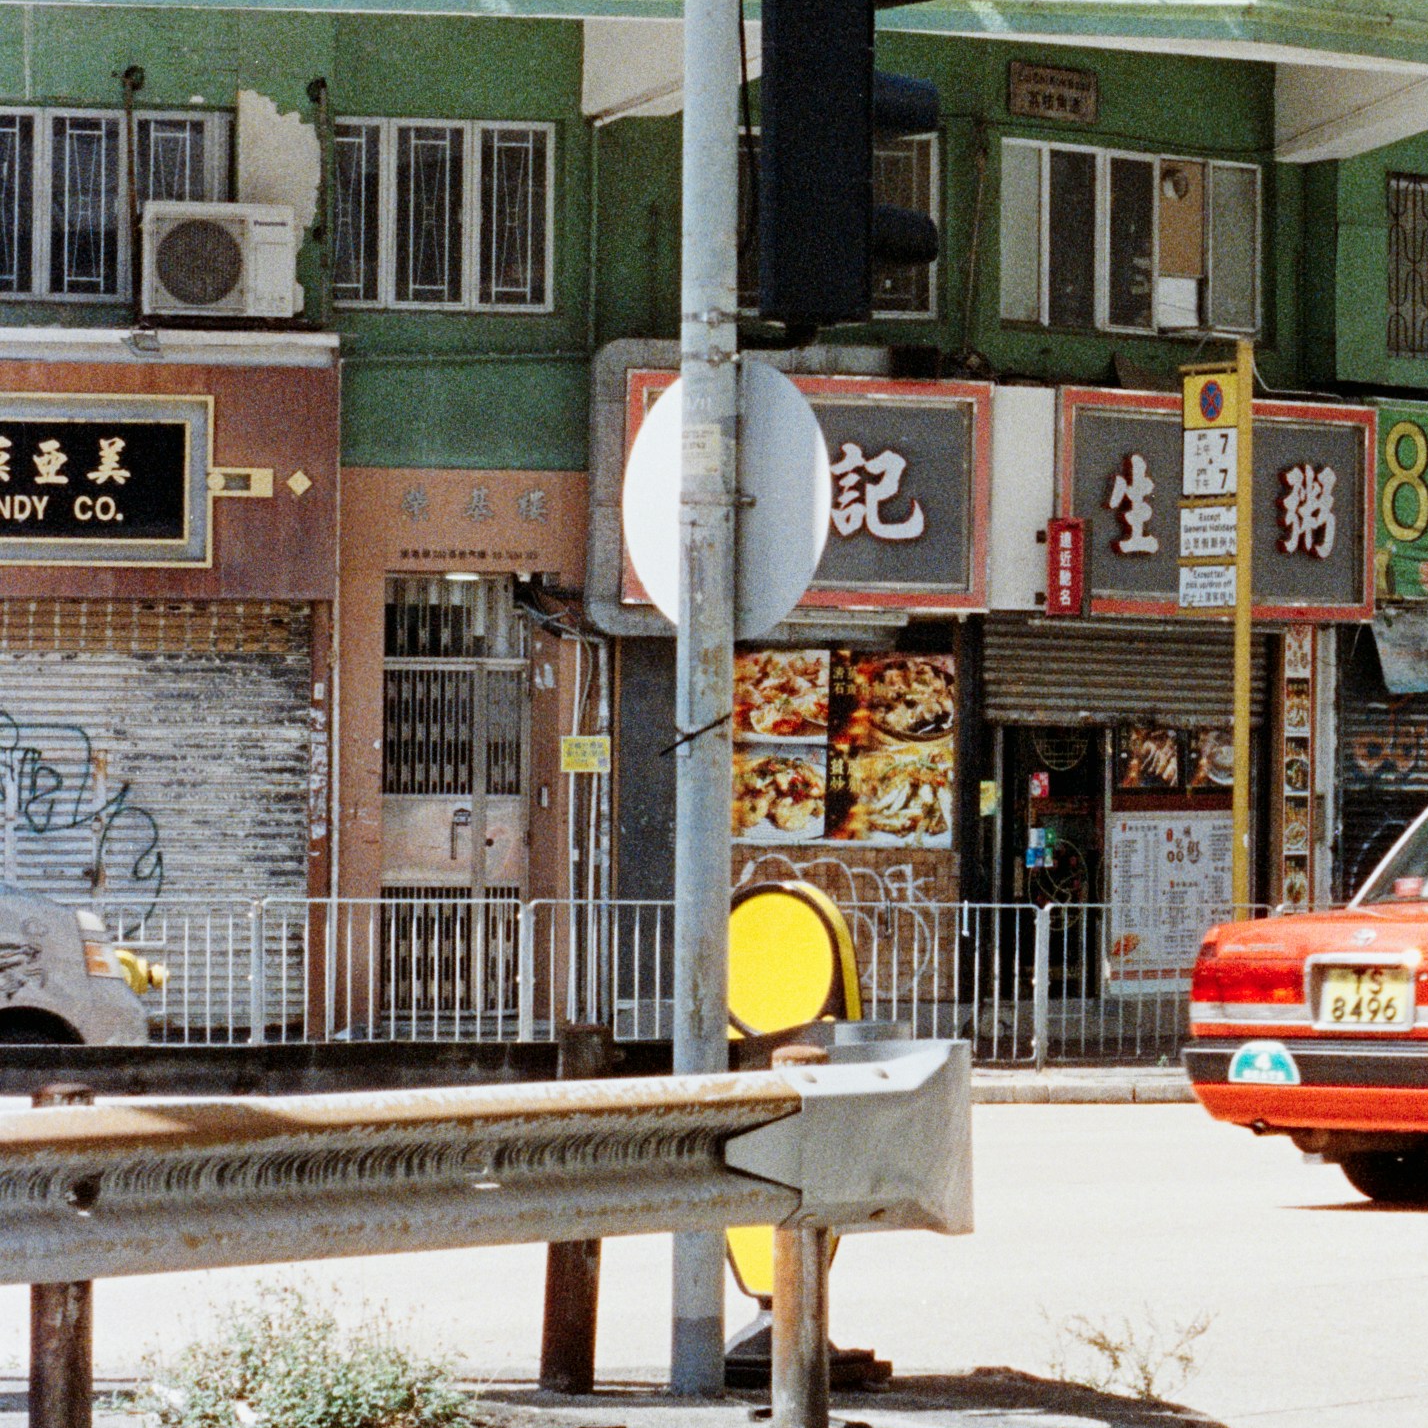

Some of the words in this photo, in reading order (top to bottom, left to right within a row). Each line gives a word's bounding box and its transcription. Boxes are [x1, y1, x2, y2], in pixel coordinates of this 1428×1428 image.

[1219, 433, 1229, 455] 7
[829, 441, 925, 540] 記
[1218, 468, 1229, 490] 7
[73, 495, 124, 521] CO.
[1332, 996, 1397, 1022] 8496
